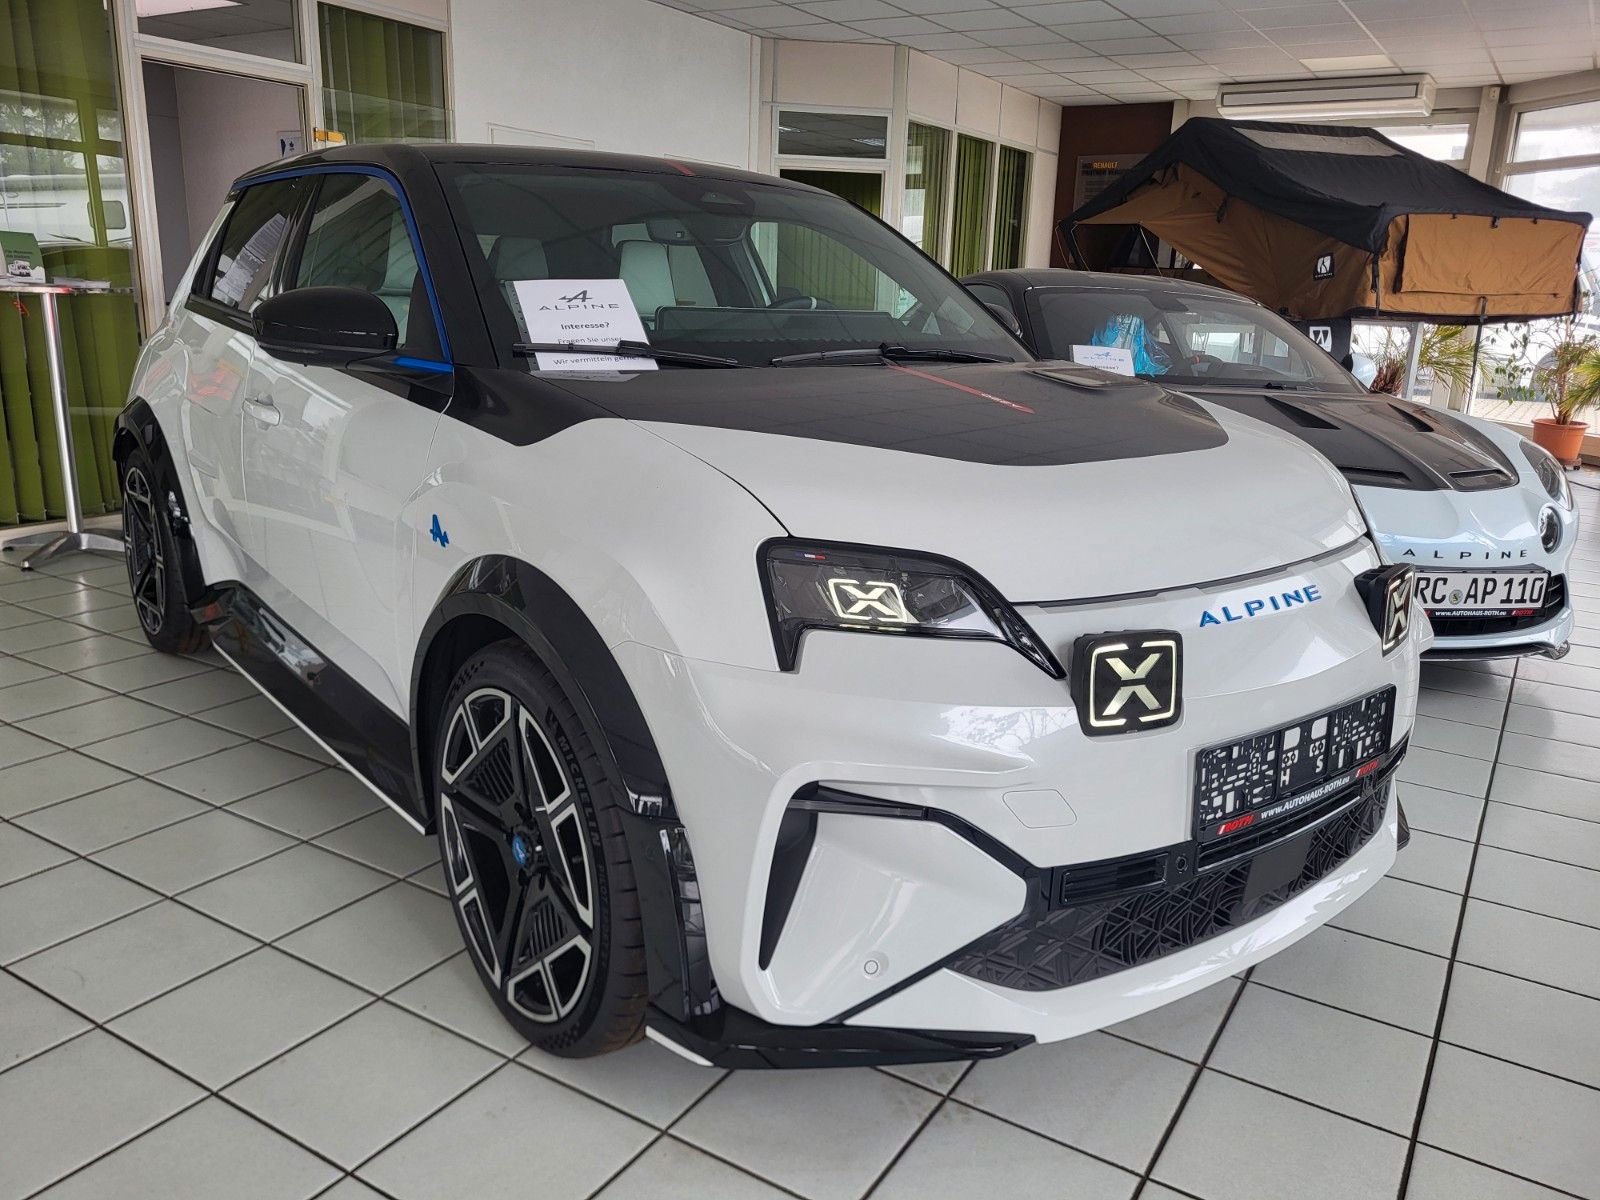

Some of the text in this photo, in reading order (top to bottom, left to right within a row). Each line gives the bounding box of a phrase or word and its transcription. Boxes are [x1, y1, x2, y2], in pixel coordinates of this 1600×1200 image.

[539, 303, 620, 311] ALPINE
[561, 322, 610, 330] Interesse?
[570, 355, 613, 364] vermitteln
[1403, 548, 1528, 560] ALPINE
[1414, 577, 1545, 604] RC AP 110
[1199, 584, 1322, 628] ALPINE
[557, 735, 601, 847] MICHELIN
[1222, 814, 1254, 834] ROTH
[1260, 775, 1351, 820] www.AUTOHAUS-ROTH.eu
